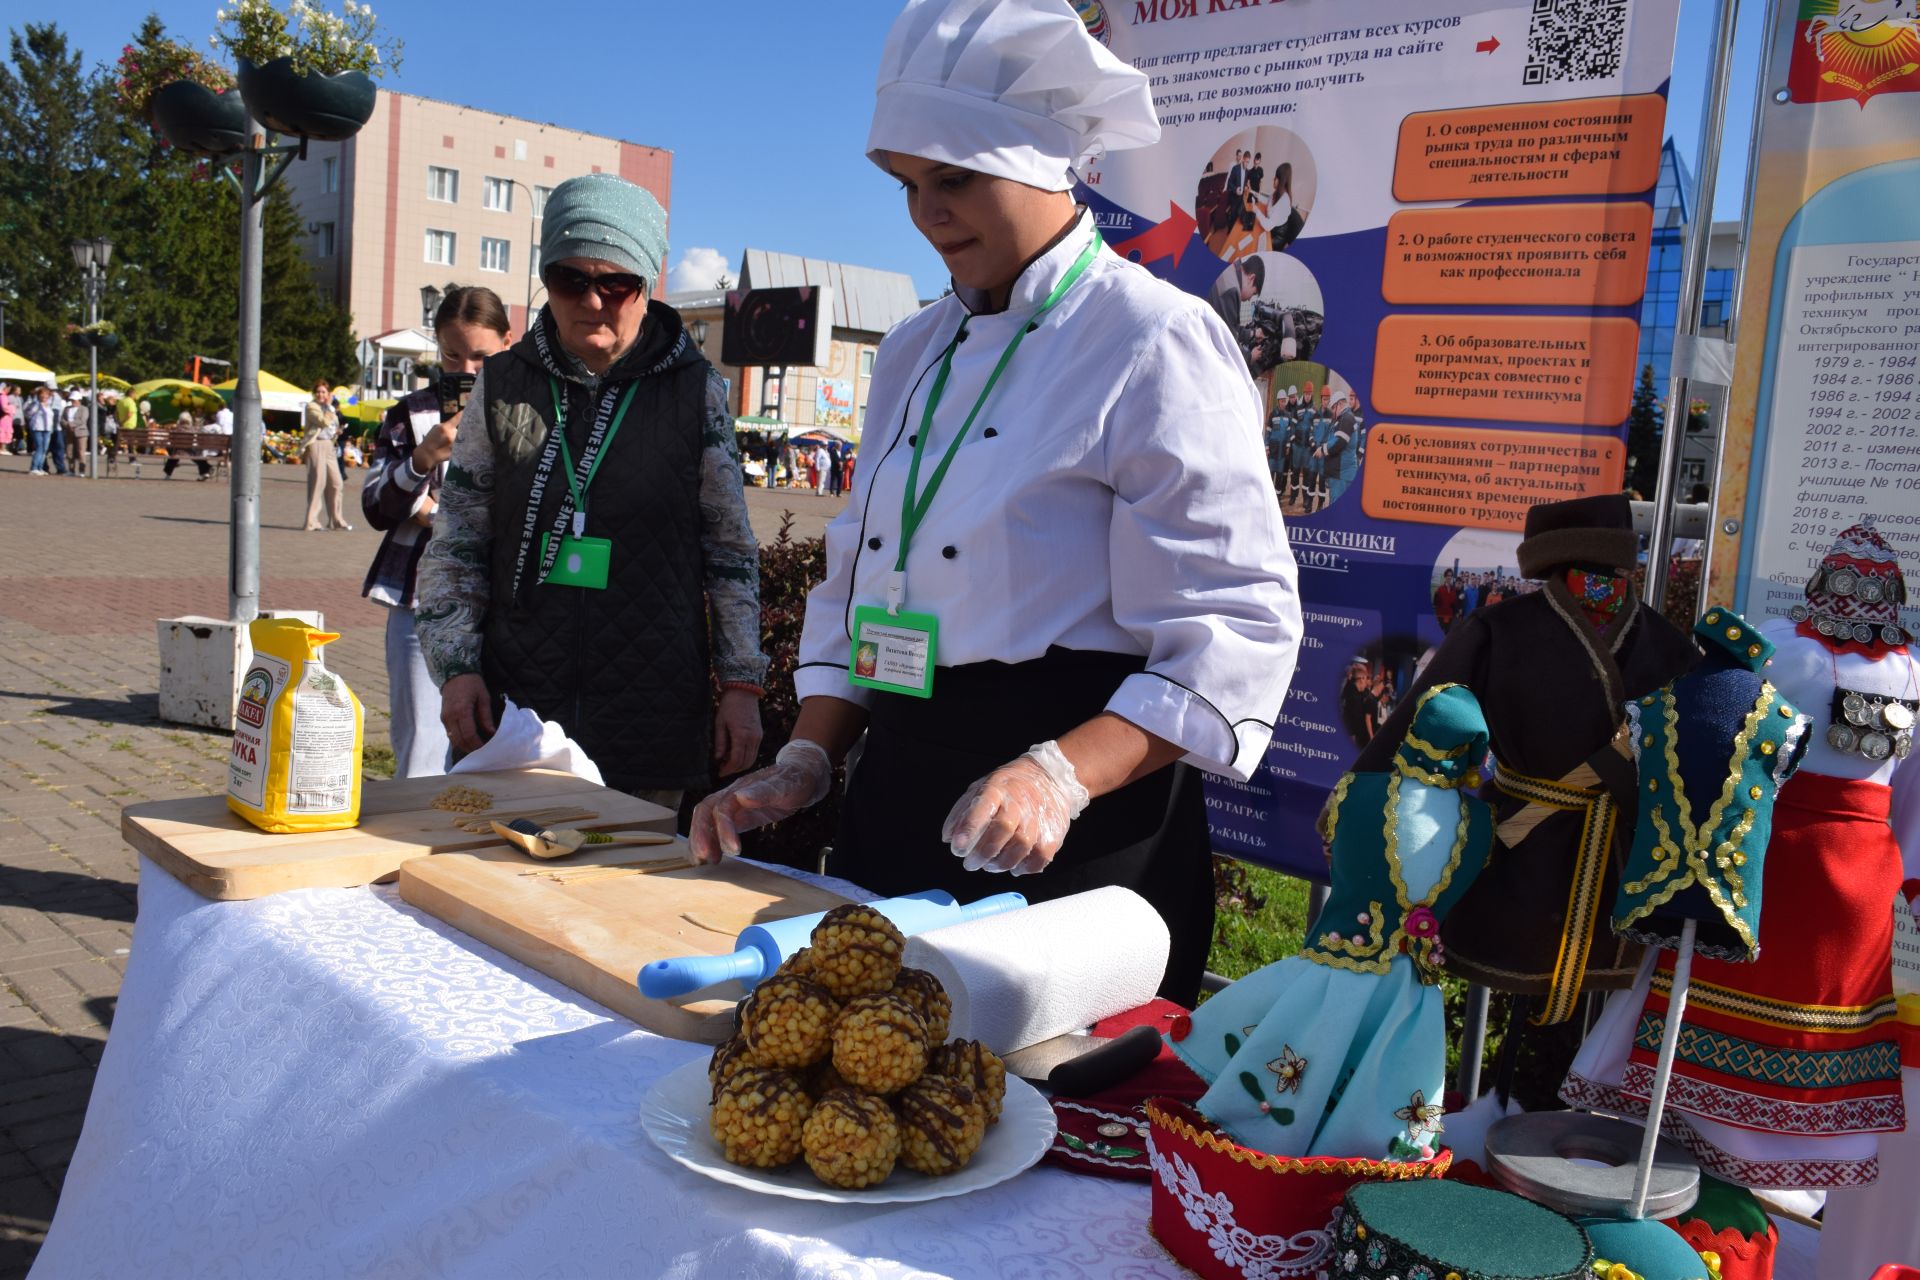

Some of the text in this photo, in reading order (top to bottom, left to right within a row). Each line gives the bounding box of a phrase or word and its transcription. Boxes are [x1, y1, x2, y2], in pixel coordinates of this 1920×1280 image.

[1133, 15, 1461, 69] Наш центр предлагает студентам всех курсов
[1150, 39, 1444, 87] ать знакомство с рынком труда на сайте
[1152, 71, 1365, 109] икума, где возможно получить
[1199, 101, 1297, 125] информацию:
[1425, 113, 1633, 137] 1. О современном состоянии
[1425, 131, 1629, 156] рынка труда по различным
[1429, 148, 1620, 169] специальностям и сферам
[1469, 168, 1569, 184] деятельности
[1398, 231, 1636, 249] 2. О работе студенческого совета
[1403, 248, 1627, 264] и возможностях проявить себя
[1848, 255, 1920, 269] Государст
[1440, 265, 1581, 281] как профессионала
[1805, 273, 1892, 287] учреждение
[1804, 290, 1894, 303] профильных
[1802, 309, 1868, 320] техникум
[1800, 323, 1898, 337] Октябрьского
[1420, 334, 1587, 351] 3. Об образовательных
[1798, 342, 1920, 354] интегрированног
[1415, 354, 1591, 369] программах, проектах и
[1814, 357, 1849, 368] 1979
[1879, 356, 1917, 367] 1984
[1418, 369, 1583, 385] конкурсах совместно с
[1812, 374, 1847, 385] 1984
[1877, 374, 1914, 385] 1986
[598, 385, 620, 415] LOVE
[1415, 386, 1582, 404] партнерами техникума
[1810, 391, 1845, 401] 1986
[1874, 391, 1911, 402] 1994
[1808, 408, 1842, 418] 1994
[1872, 408, 1911, 419] 2002
[588, 415, 609, 445] LOVE
[1806, 424, 1842, 435] 2002
[1377, 433, 1613, 460] 4. Об условиях сотрудничества с
[1804, 440, 1838, 451] 2011
[538, 444, 559, 472] LOVE
[577, 446, 598, 480] LOVE
[1387, 452, 1496, 469] организациями
[1509, 461, 1601, 477] партнерами
[1801, 456, 1838, 468] 2013
[528, 473, 548, 504] LOVE
[1396, 470, 1586, 492] техникума, об актуальных
[1798, 475, 1866, 488] училище
[1870, 477, 1889, 488] №
[1401, 484, 1472, 500] вакансиях
[1797, 491, 1869, 505] филиала.
[1382, 499, 1466, 516] постоянного
[1793, 507, 1829, 519] 2018
[523, 505, 539, 538] LOVE
[550, 505, 574, 535] LOVE
[1790, 523, 1826, 535] 2019
[543, 534, 562, 567] LOVE
[1279, 713, 1337, 734] Н-Сервис»
[1270, 739, 1340, 762] рвисНурлат»
[1216, 827, 1267, 848] «КАМАЗ»
